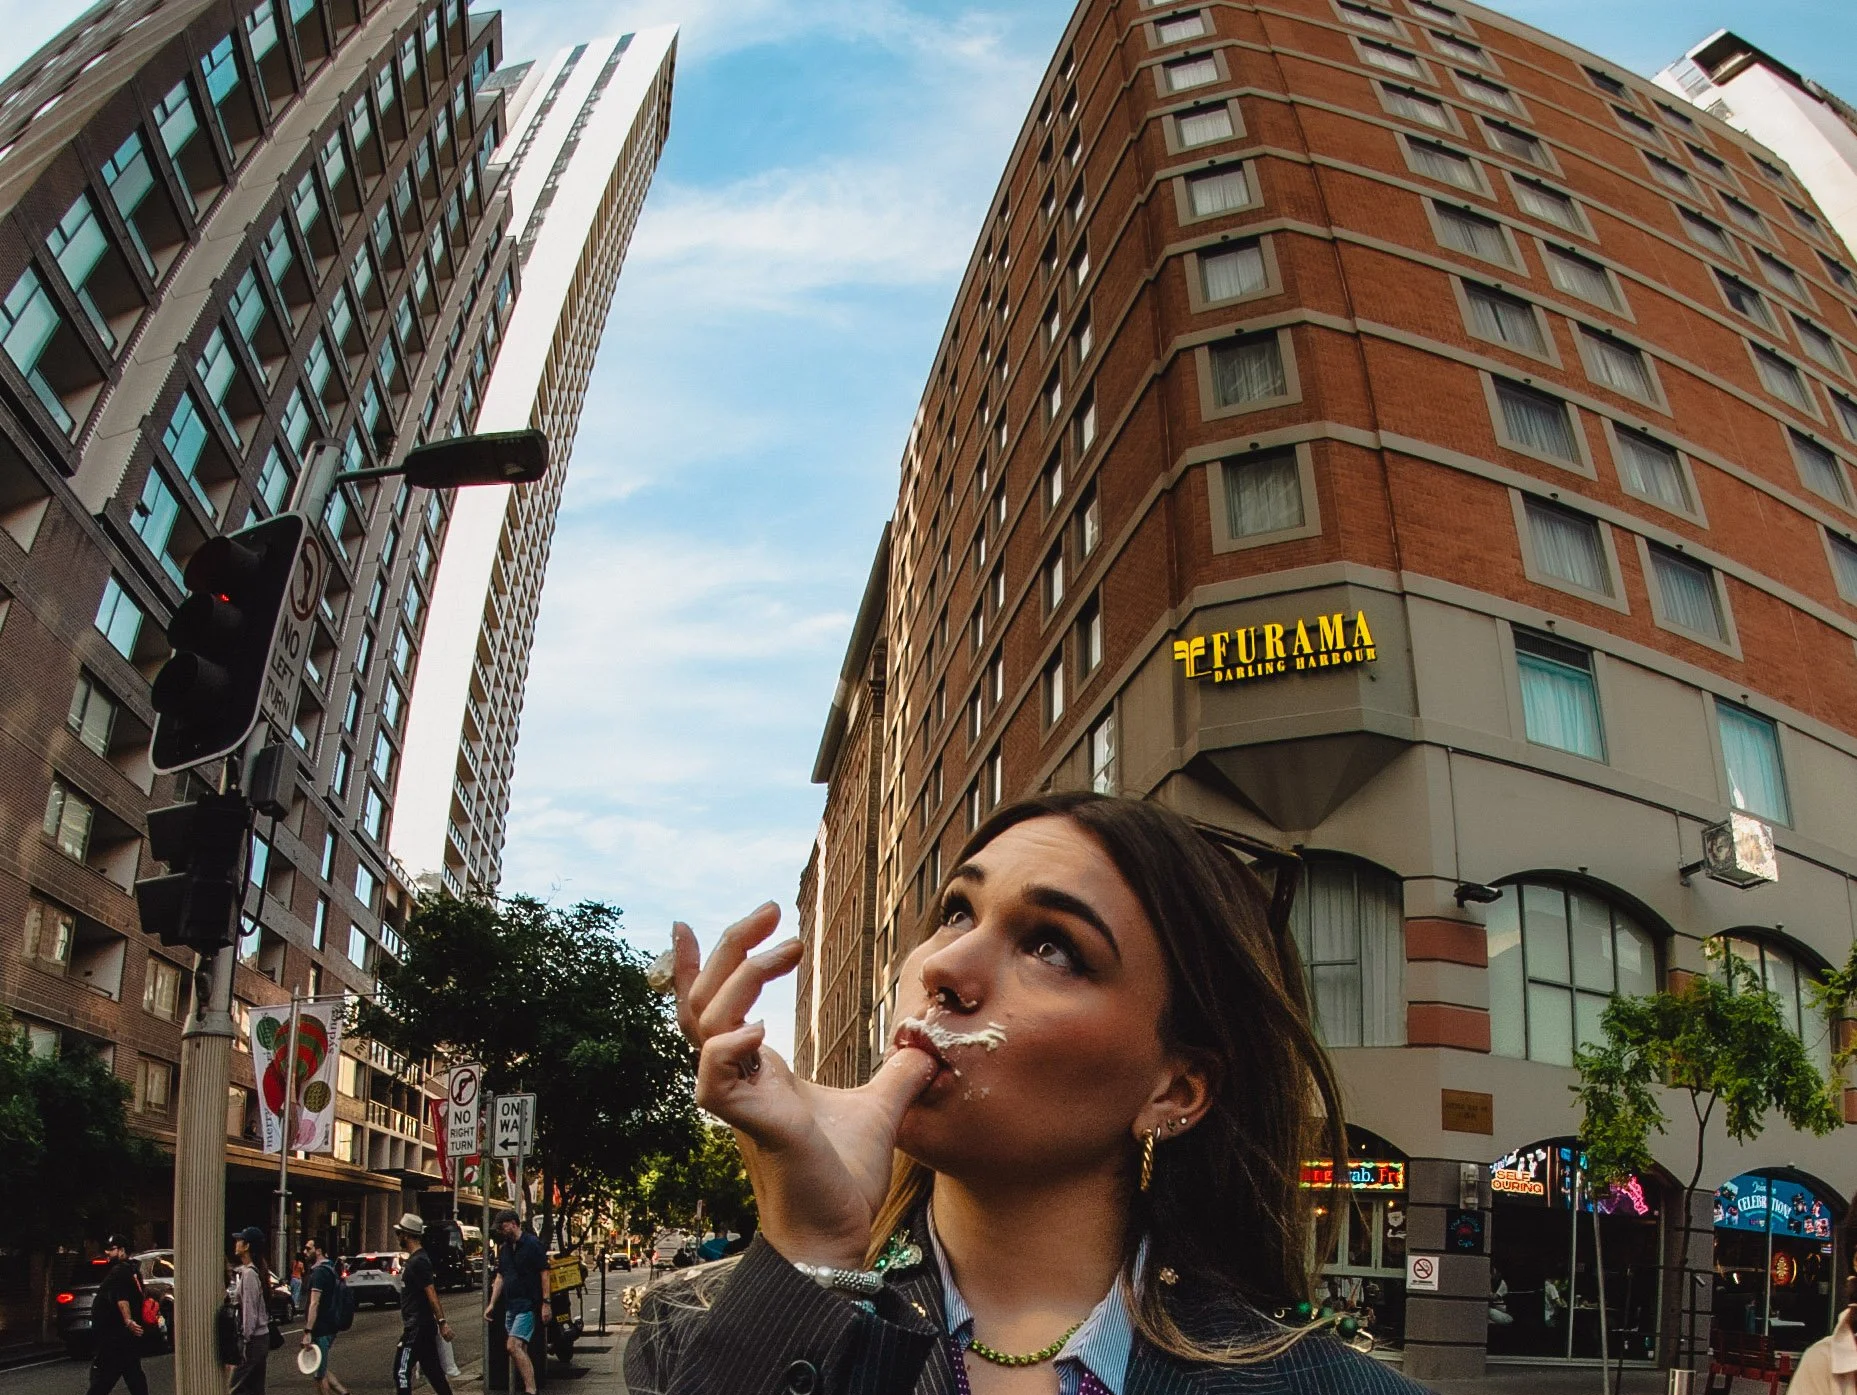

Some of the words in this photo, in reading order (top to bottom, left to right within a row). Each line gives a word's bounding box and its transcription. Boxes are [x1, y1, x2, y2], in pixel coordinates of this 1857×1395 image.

[280, 614, 300, 660] NO
[1212, 610, 1375, 669] FURAMA
[271, 648, 295, 690] LEFT
[1214, 660, 1286, 683] DARLING
[1296, 647, 1377, 670] HARBOUR
[266, 675, 290, 721] TURN
[454, 1110, 471, 1125] NO
[501, 1100, 528, 1117] ON
[265, 1108, 273, 1149] merry
[450, 1126, 475, 1139] RIGHT
[500, 1118, 528, 1133] WA
[450, 1140, 473, 1152] TURN
[1738, 1195, 1792, 1219] CELEBRTION!
